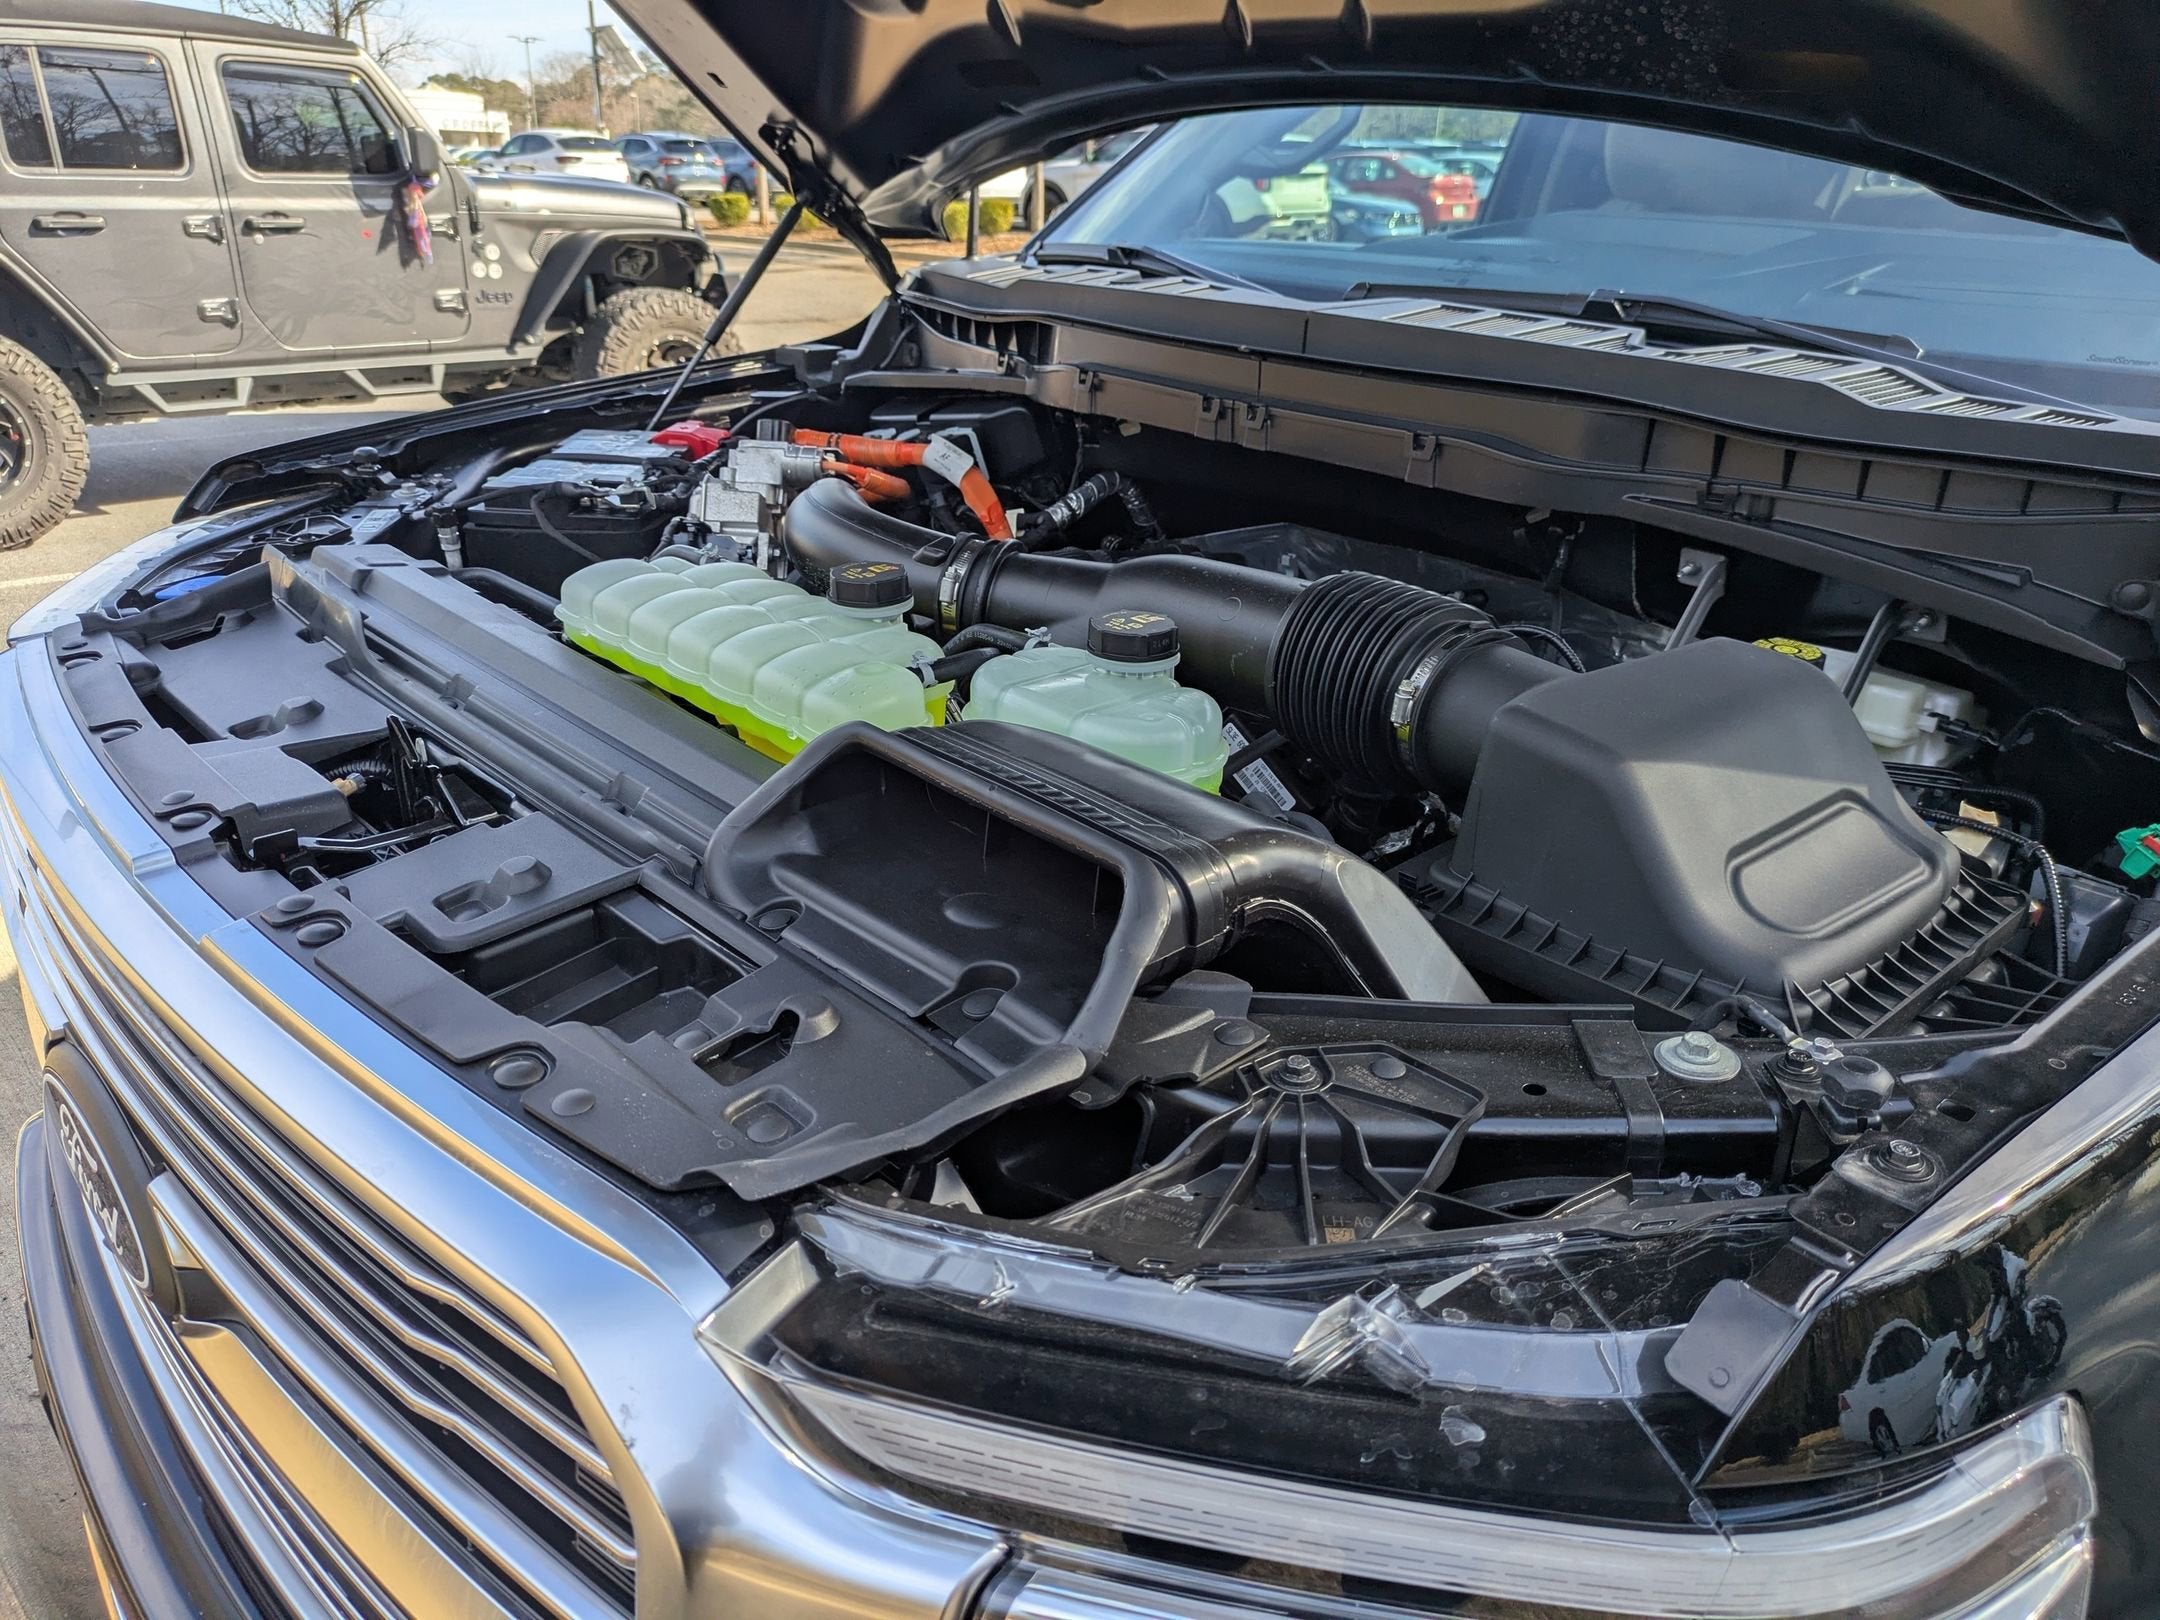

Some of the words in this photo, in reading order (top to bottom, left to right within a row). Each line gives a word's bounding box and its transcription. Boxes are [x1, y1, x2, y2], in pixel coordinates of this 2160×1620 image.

[475, 289, 513, 305] Jeep
[60, 1103, 123, 1256] Ford
[1322, 1215, 1374, 1229] LH-AG
